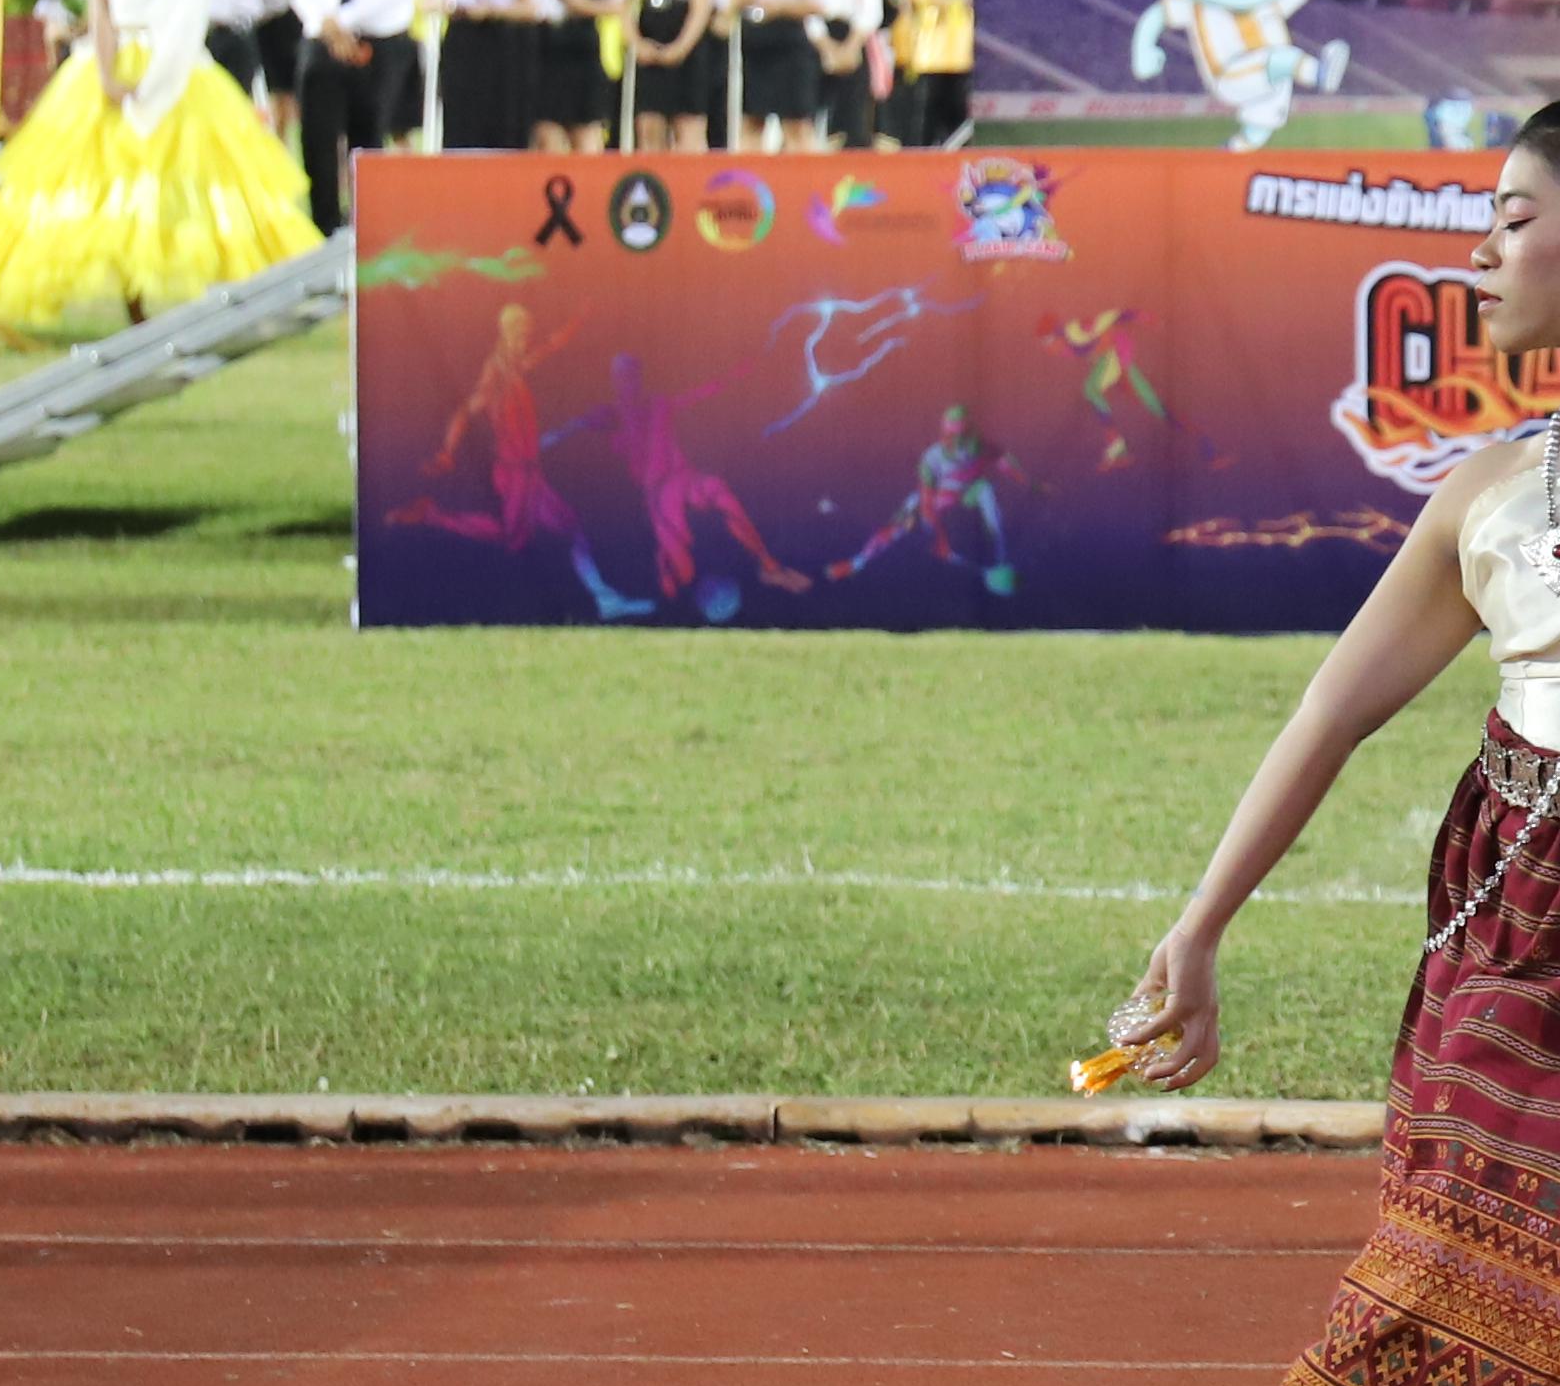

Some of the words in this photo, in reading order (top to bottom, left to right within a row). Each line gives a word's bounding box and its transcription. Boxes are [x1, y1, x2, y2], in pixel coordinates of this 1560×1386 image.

[1248, 169, 1502, 232] การแข่งขันกีฬ
